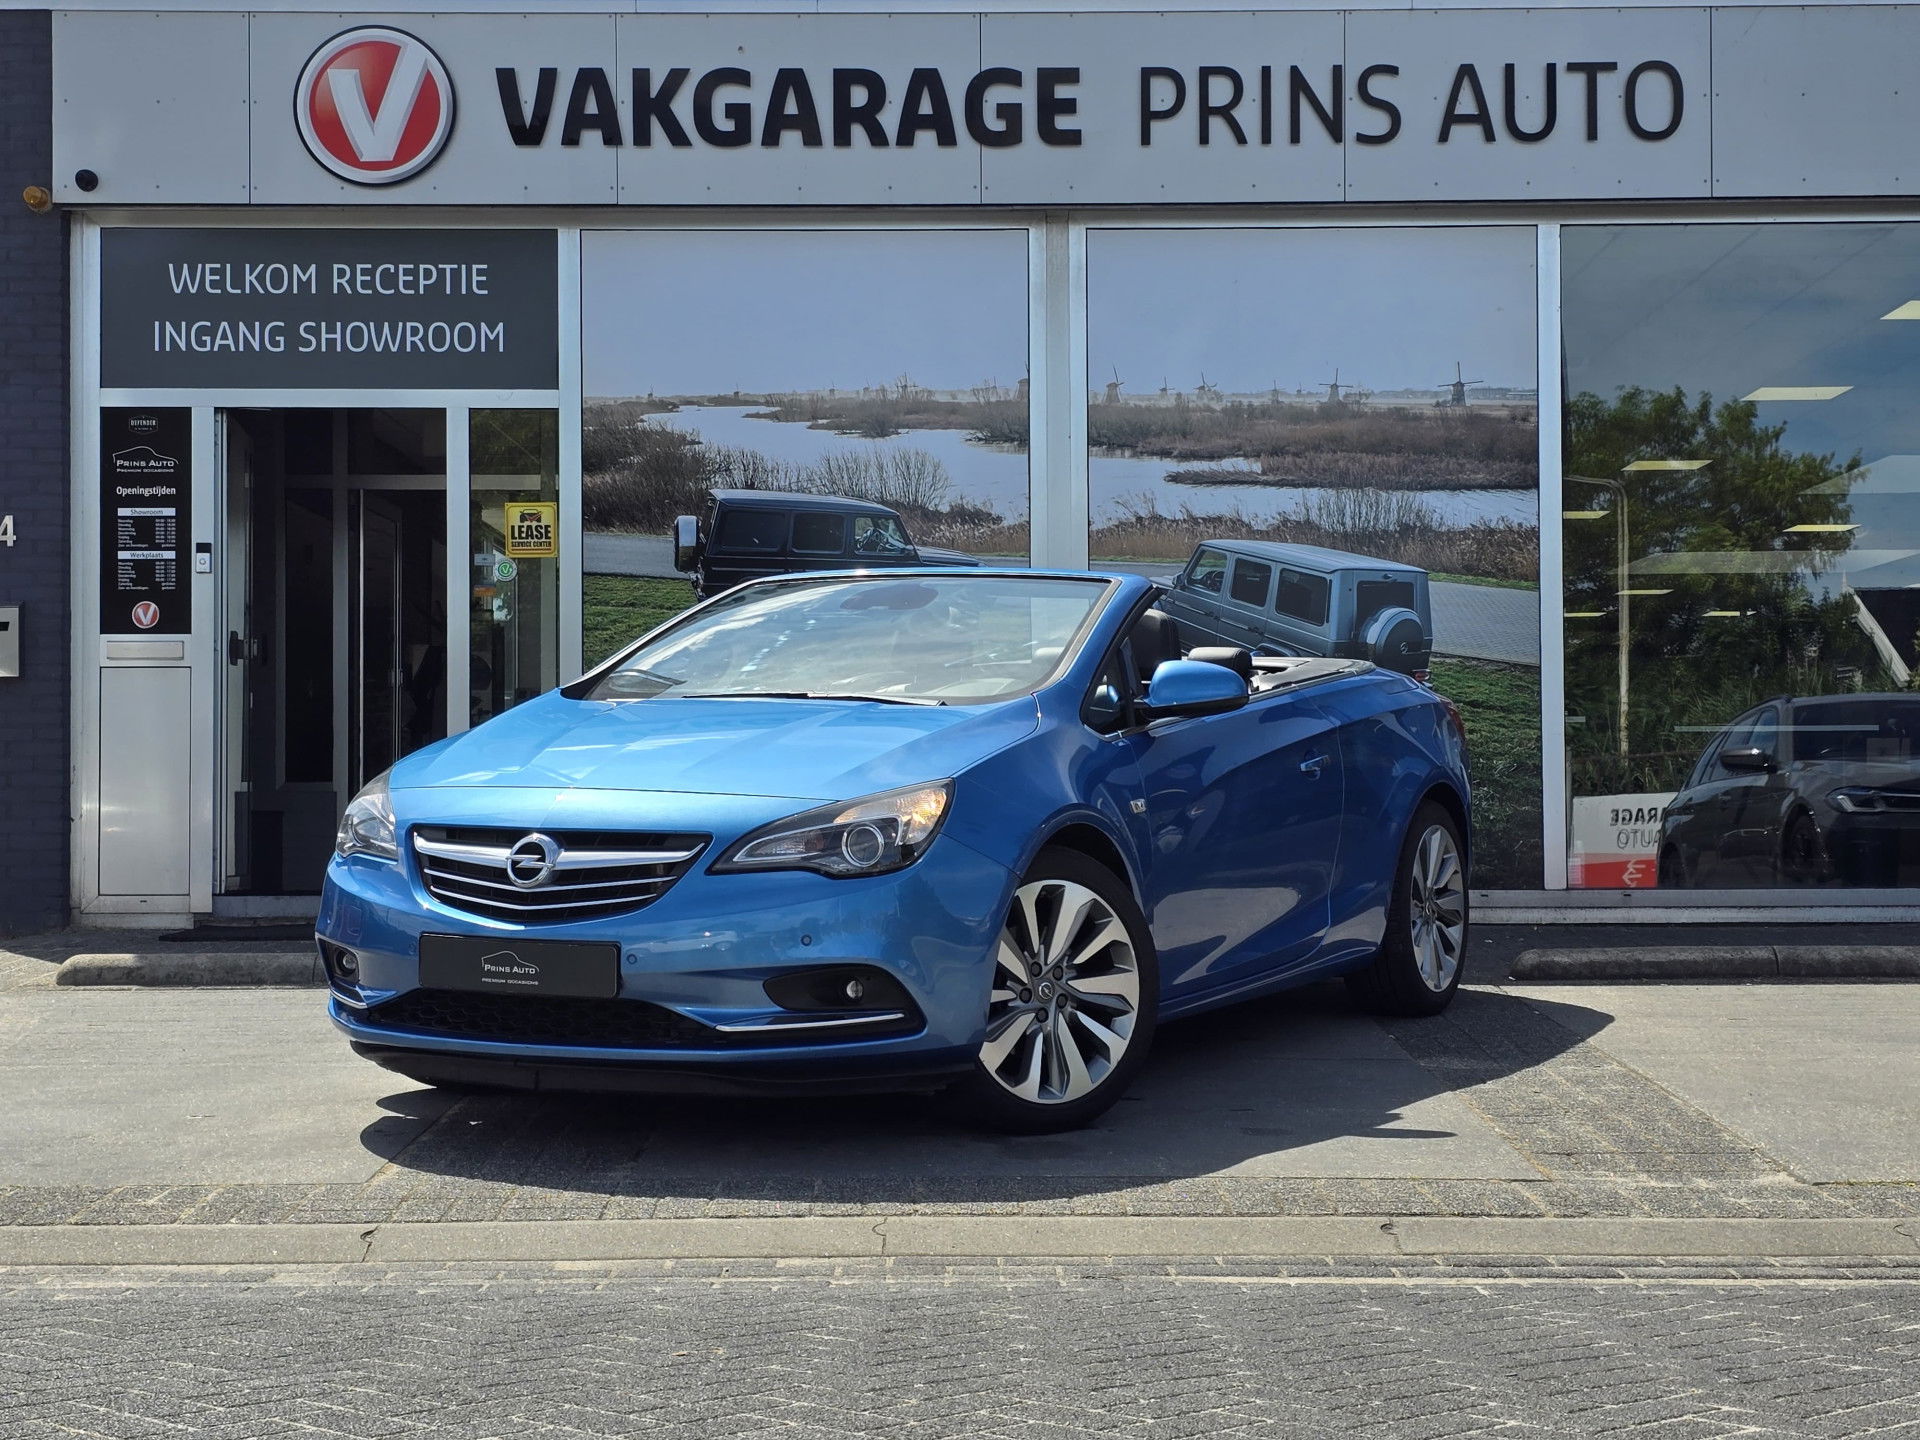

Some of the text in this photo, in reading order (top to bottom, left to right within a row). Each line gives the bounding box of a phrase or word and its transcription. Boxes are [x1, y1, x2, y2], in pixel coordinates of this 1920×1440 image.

[494, 60, 1684, 147] VAKGARAGE PRINS AUTO
[168, 263, 489, 295] WELKOM RECEPTIE
[153, 321, 505, 353] INGANG SHOWROOM
[116, 485, 176, 497] Openingstijden
[510, 525, 552, 540] LEASE
[130, 551, 164, 559] Werkplaats
[484, 963, 536, 975] PRINS AUTO
